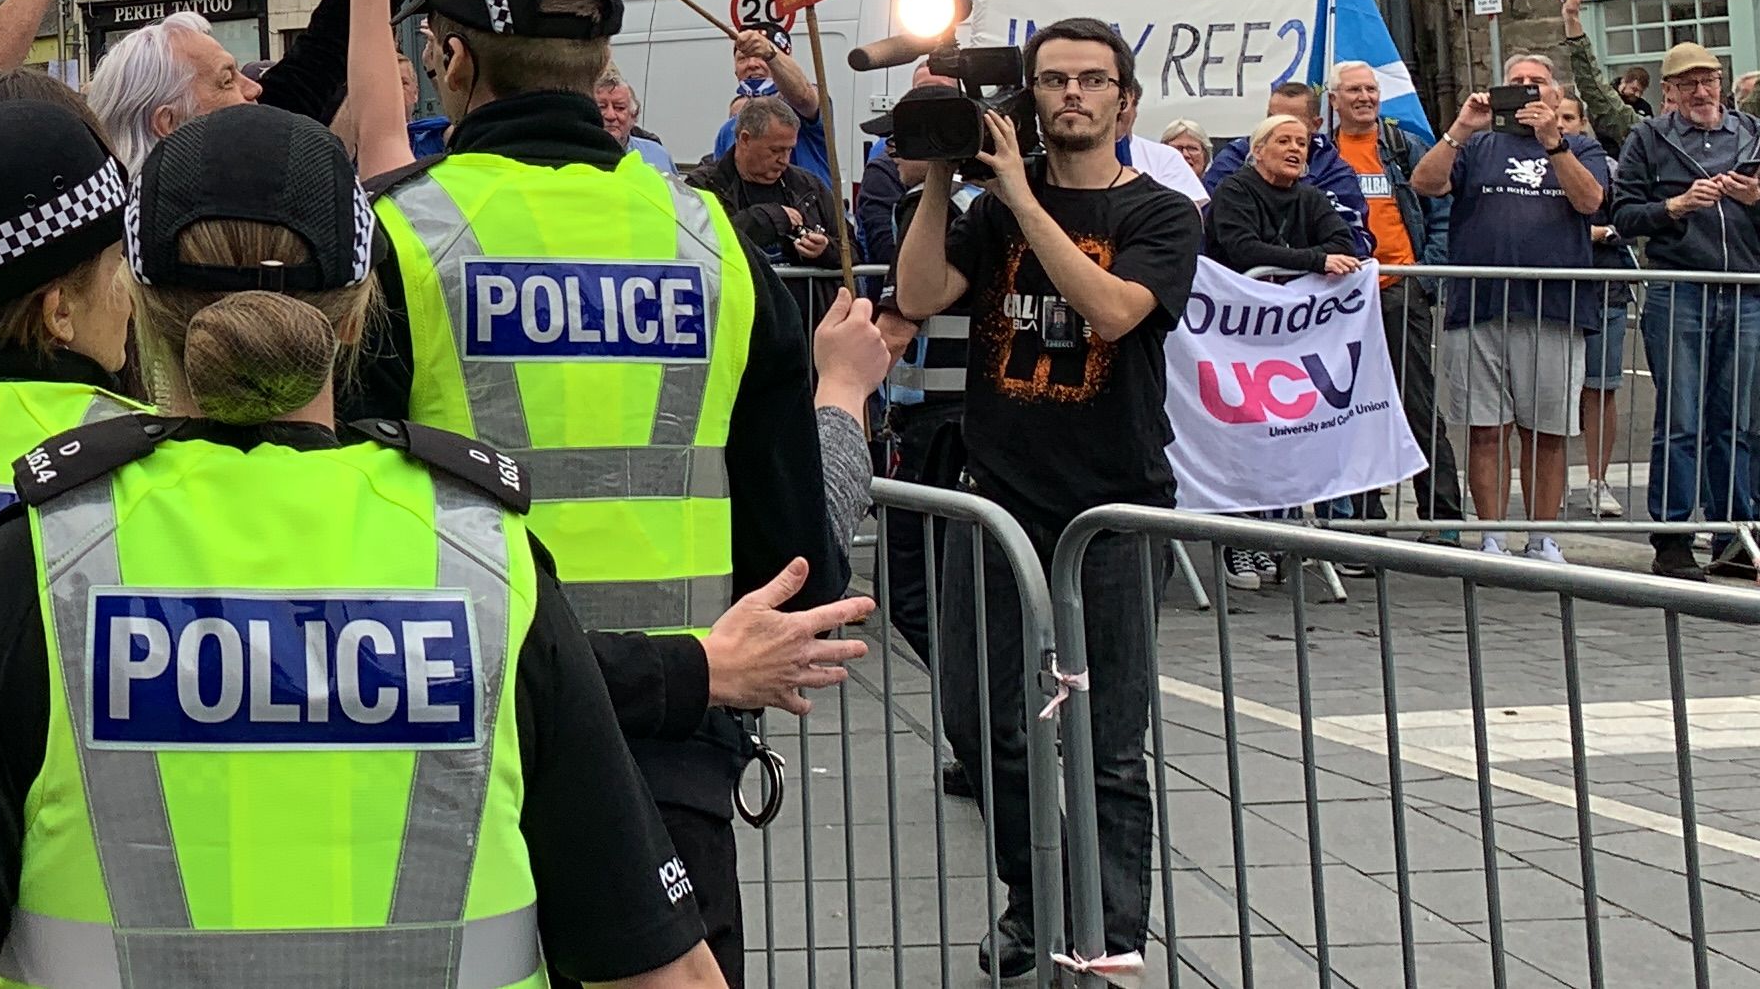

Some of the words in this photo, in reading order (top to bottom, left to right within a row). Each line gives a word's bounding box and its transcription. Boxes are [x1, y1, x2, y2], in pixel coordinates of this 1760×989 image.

[114, 2, 166, 23] PERTH
[1360, 175, 1391, 195] ALBA
[1507, 186, 1540, 197] nation
[475, 274, 698, 345] POLICE
[1183, 288, 1366, 337] Dundee
[1012, 319, 1039, 332] BLA
[1268, 418, 1320, 438] University
[1320, 415, 1337, 431] and
[1355, 400, 1390, 416] Union
[59, 440, 81, 456] D
[468, 448, 491, 465] D
[25, 447, 58, 484] 1614
[495, 452, 521, 492] 1614
[108, 615, 461, 725] POLICE
